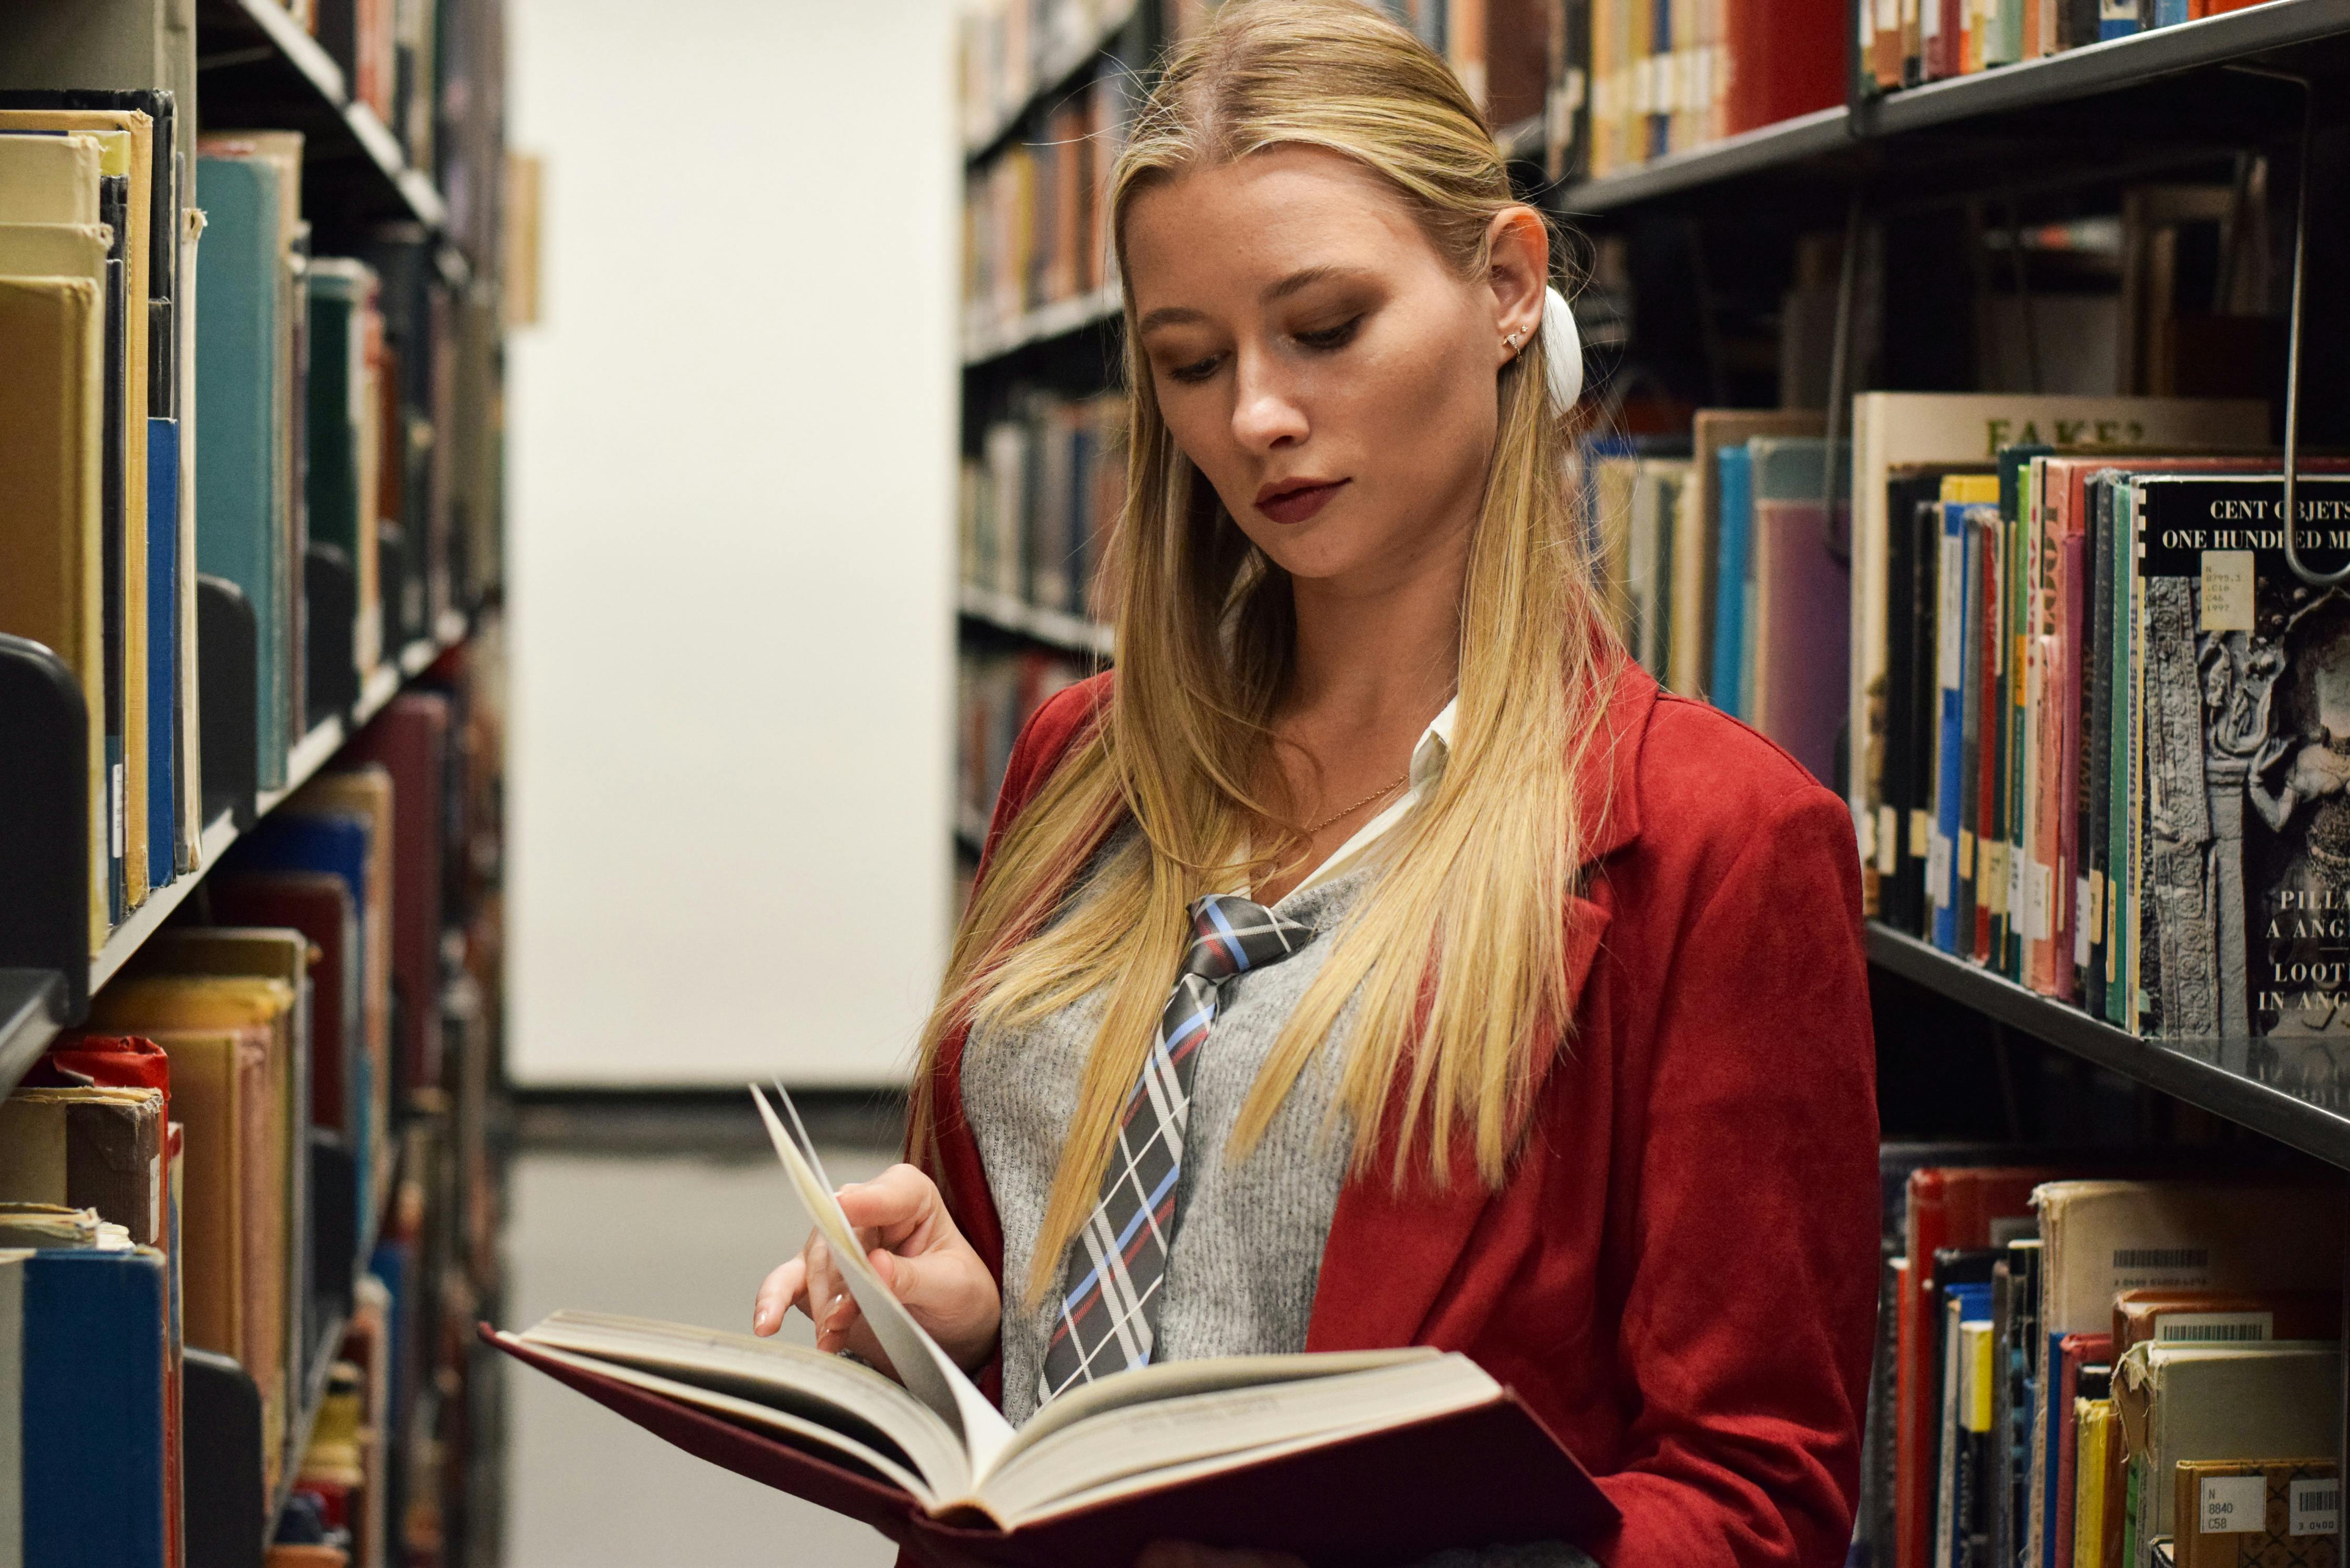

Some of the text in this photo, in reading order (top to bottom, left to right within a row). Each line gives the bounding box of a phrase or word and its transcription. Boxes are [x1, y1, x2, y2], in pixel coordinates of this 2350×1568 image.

[2210, 500, 2267, 519] CENT
[2162, 529, 2207, 549] ONE
[2266, 919, 2350, 939] A ANG
[2275, 963, 2350, 982] LOOT
[2259, 991, 2285, 1010] IN
[2208, 1489, 2215, 1500] N
[2209, 1503, 2233, 1514] 8840
[2208, 1518, 2227, 1529] C58
[2298, 1522, 2303, 1530] 3
